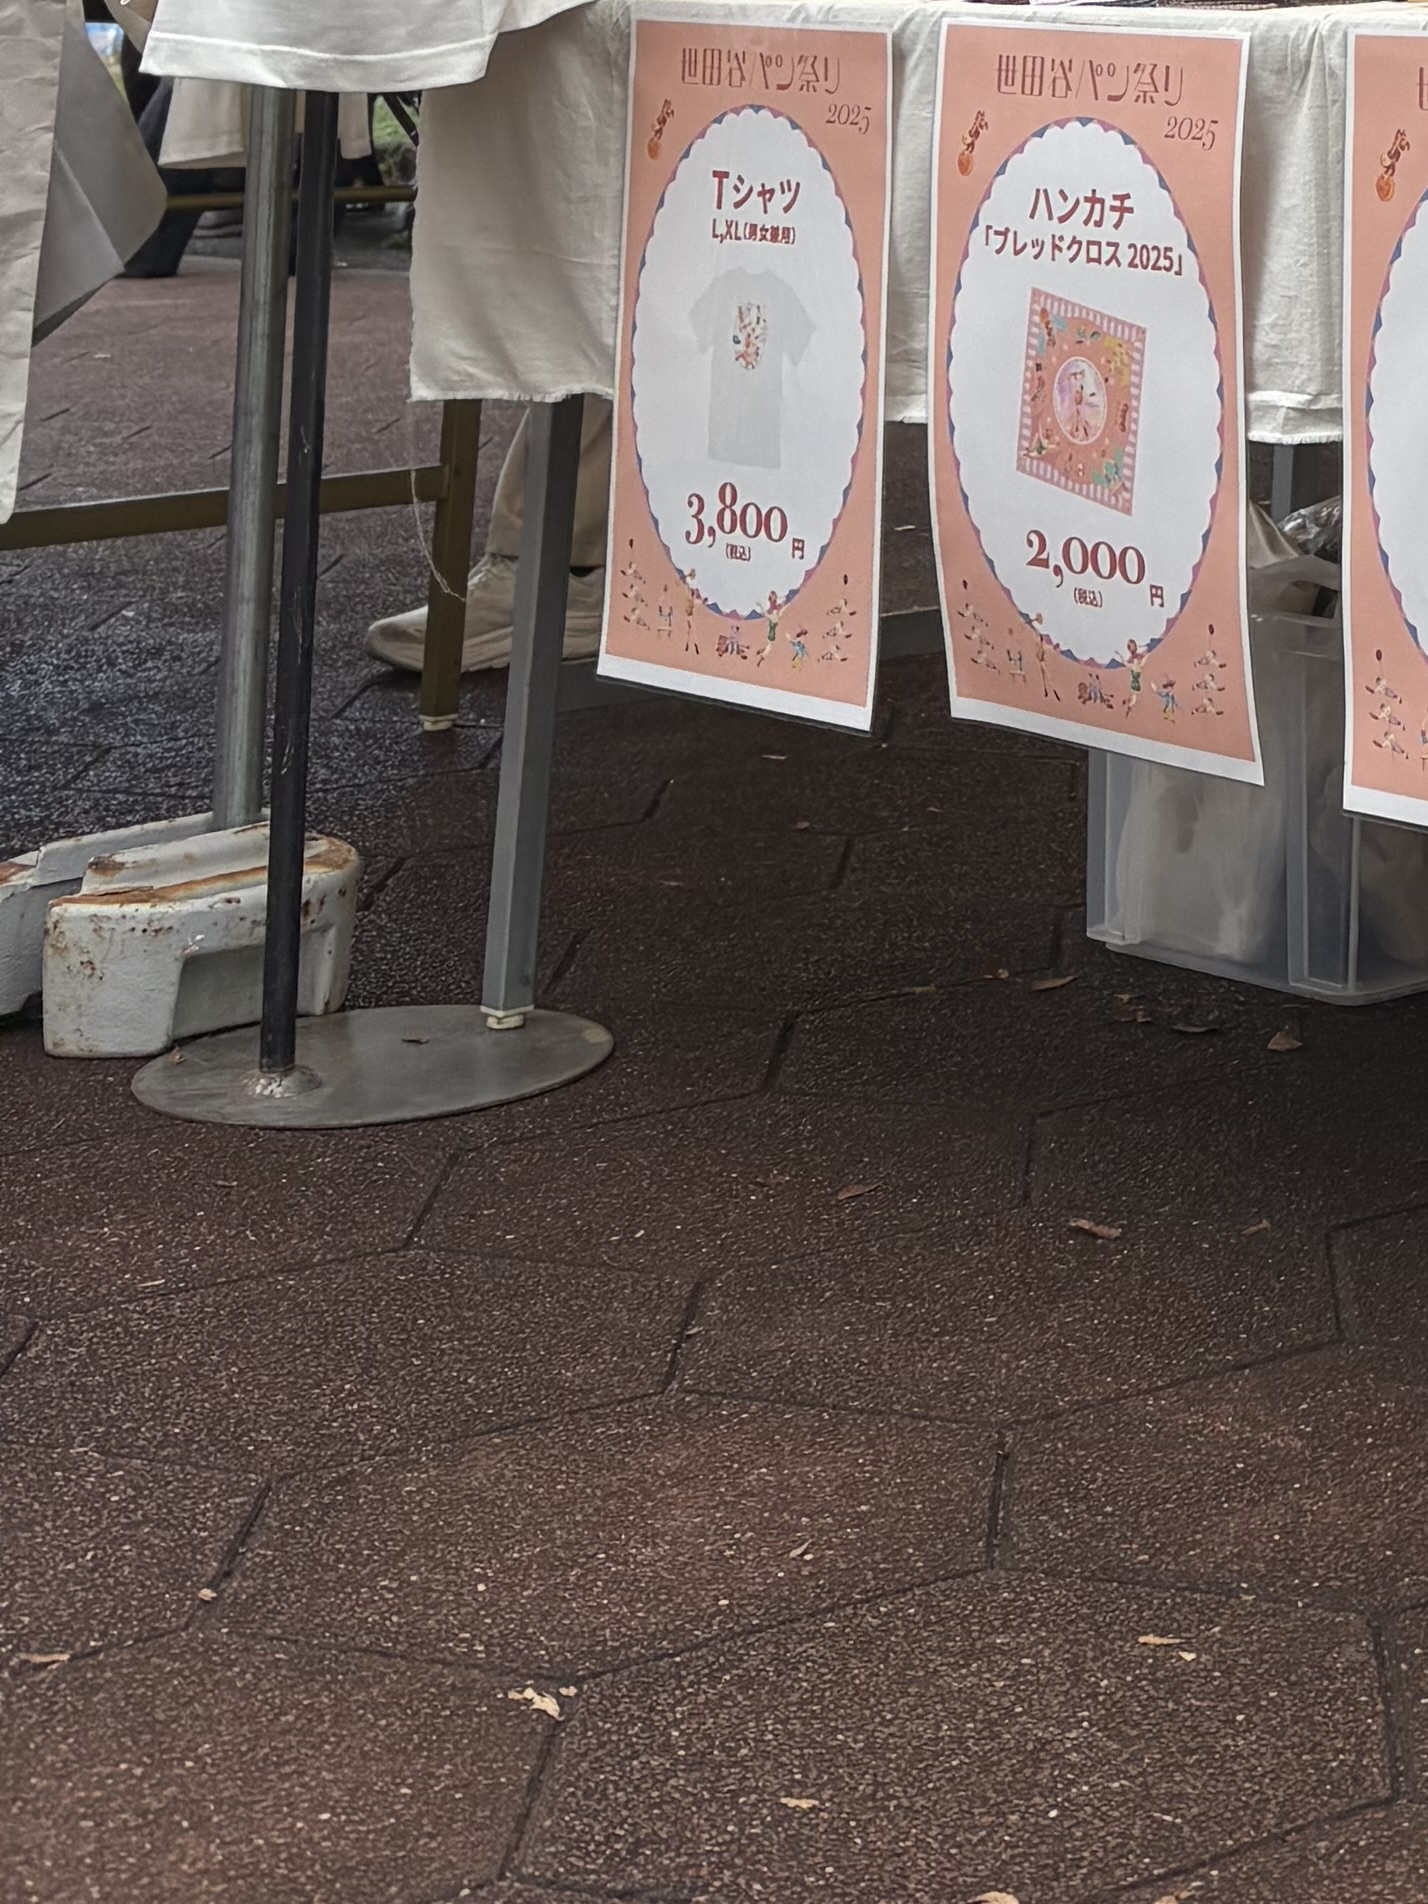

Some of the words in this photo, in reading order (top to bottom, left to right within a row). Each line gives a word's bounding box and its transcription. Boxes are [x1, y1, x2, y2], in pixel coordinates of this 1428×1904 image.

[679, 45, 842, 95] 世田谷パン祭り
[994, 53, 1185, 107] 世田谷パン祭り
[825, 102, 872, 135] 2025
[1163, 114, 1219, 151] 2025
[711, 169, 802, 216] Tシャツ
[1028, 186, 1135, 231] ハンカチ
